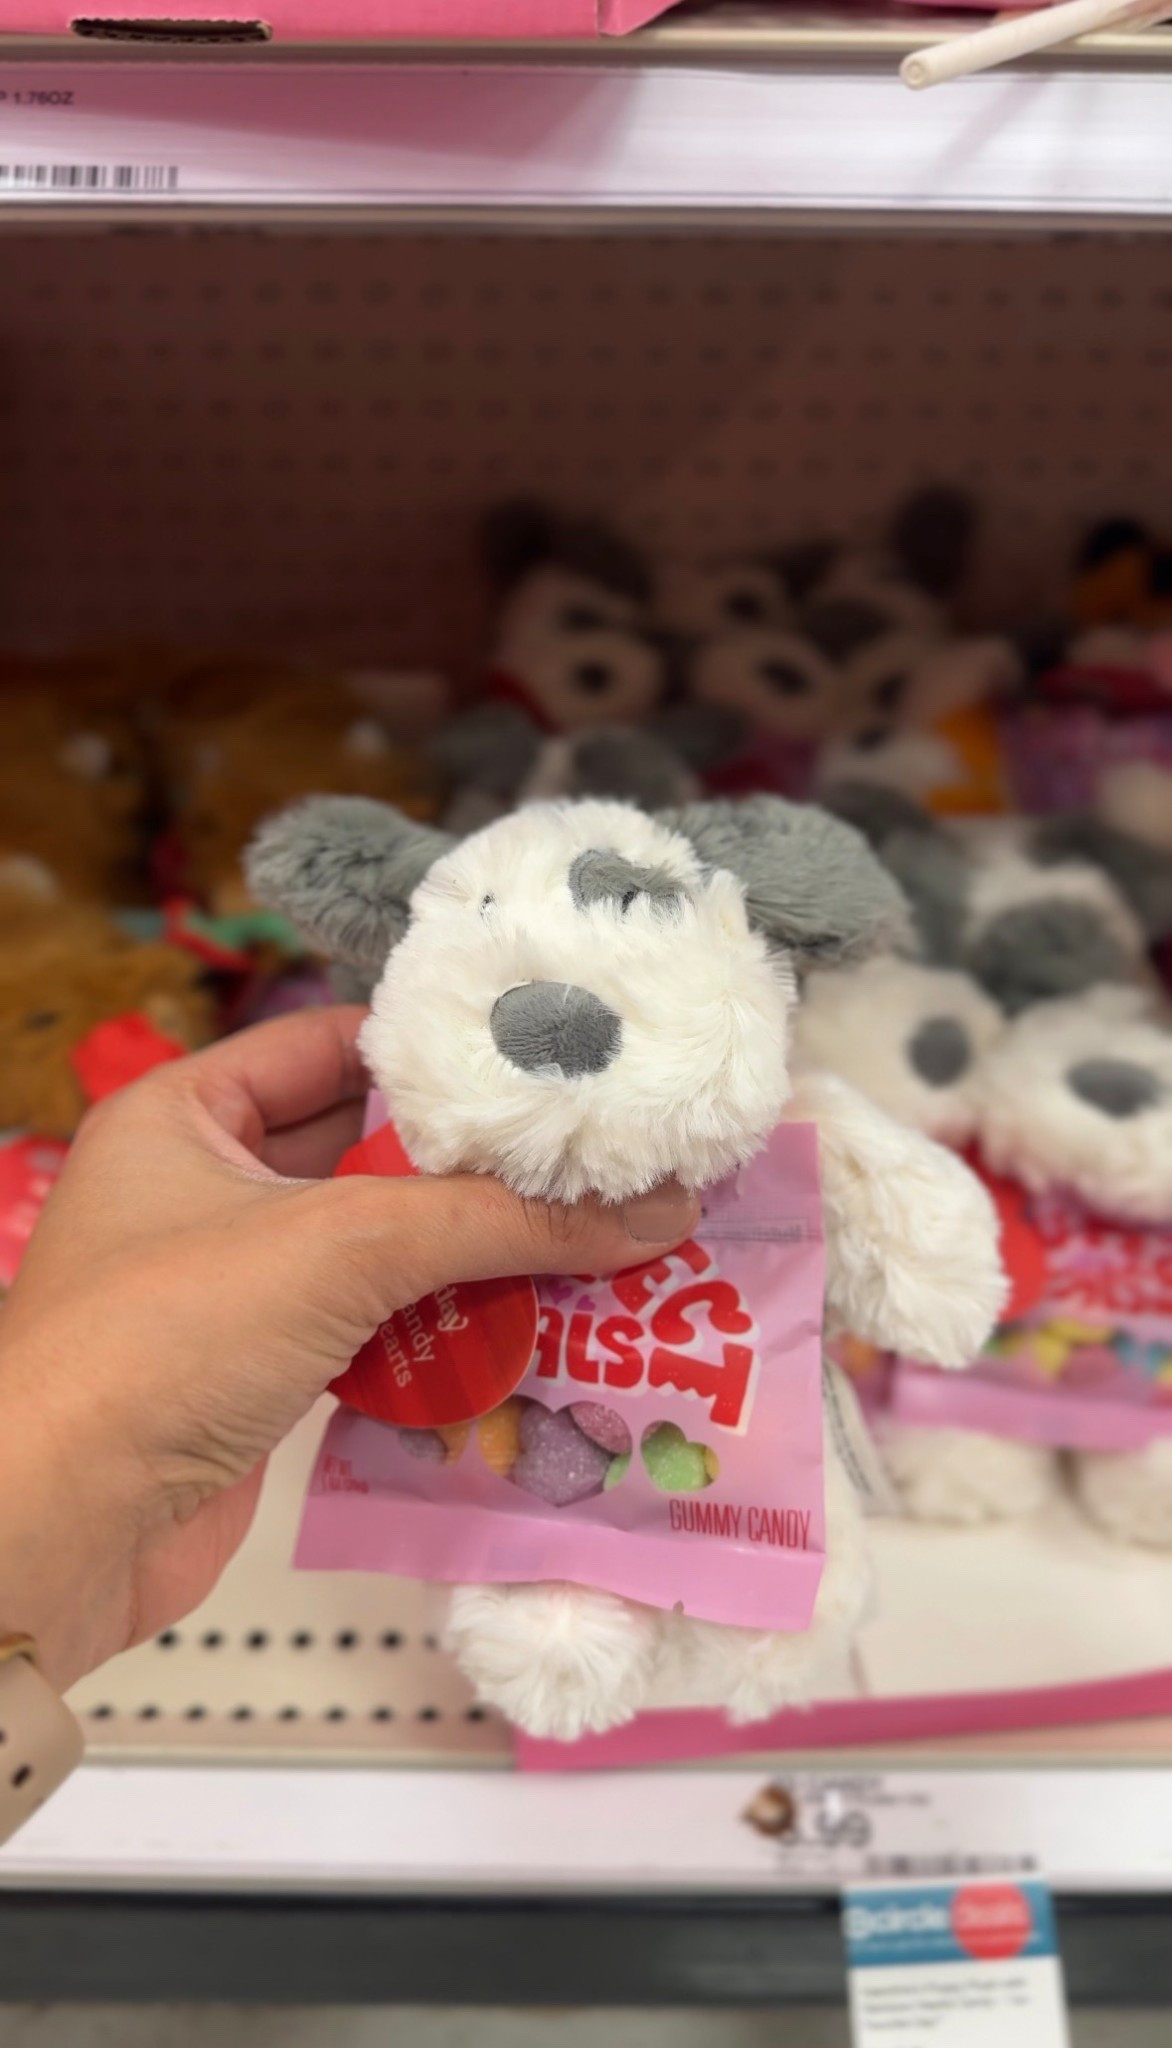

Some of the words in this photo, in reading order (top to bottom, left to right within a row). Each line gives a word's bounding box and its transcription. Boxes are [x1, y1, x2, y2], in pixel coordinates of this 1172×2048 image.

[378, 1322, 413, 1388] earts
[402, 1303, 436, 1363] andy
[534, 1305, 645, 1390] ALS
[575, 1238, 756, 1428] ECT
[669, 1499, 742, 1539] GUMMY
[748, 1506, 811, 1550] CANDY
